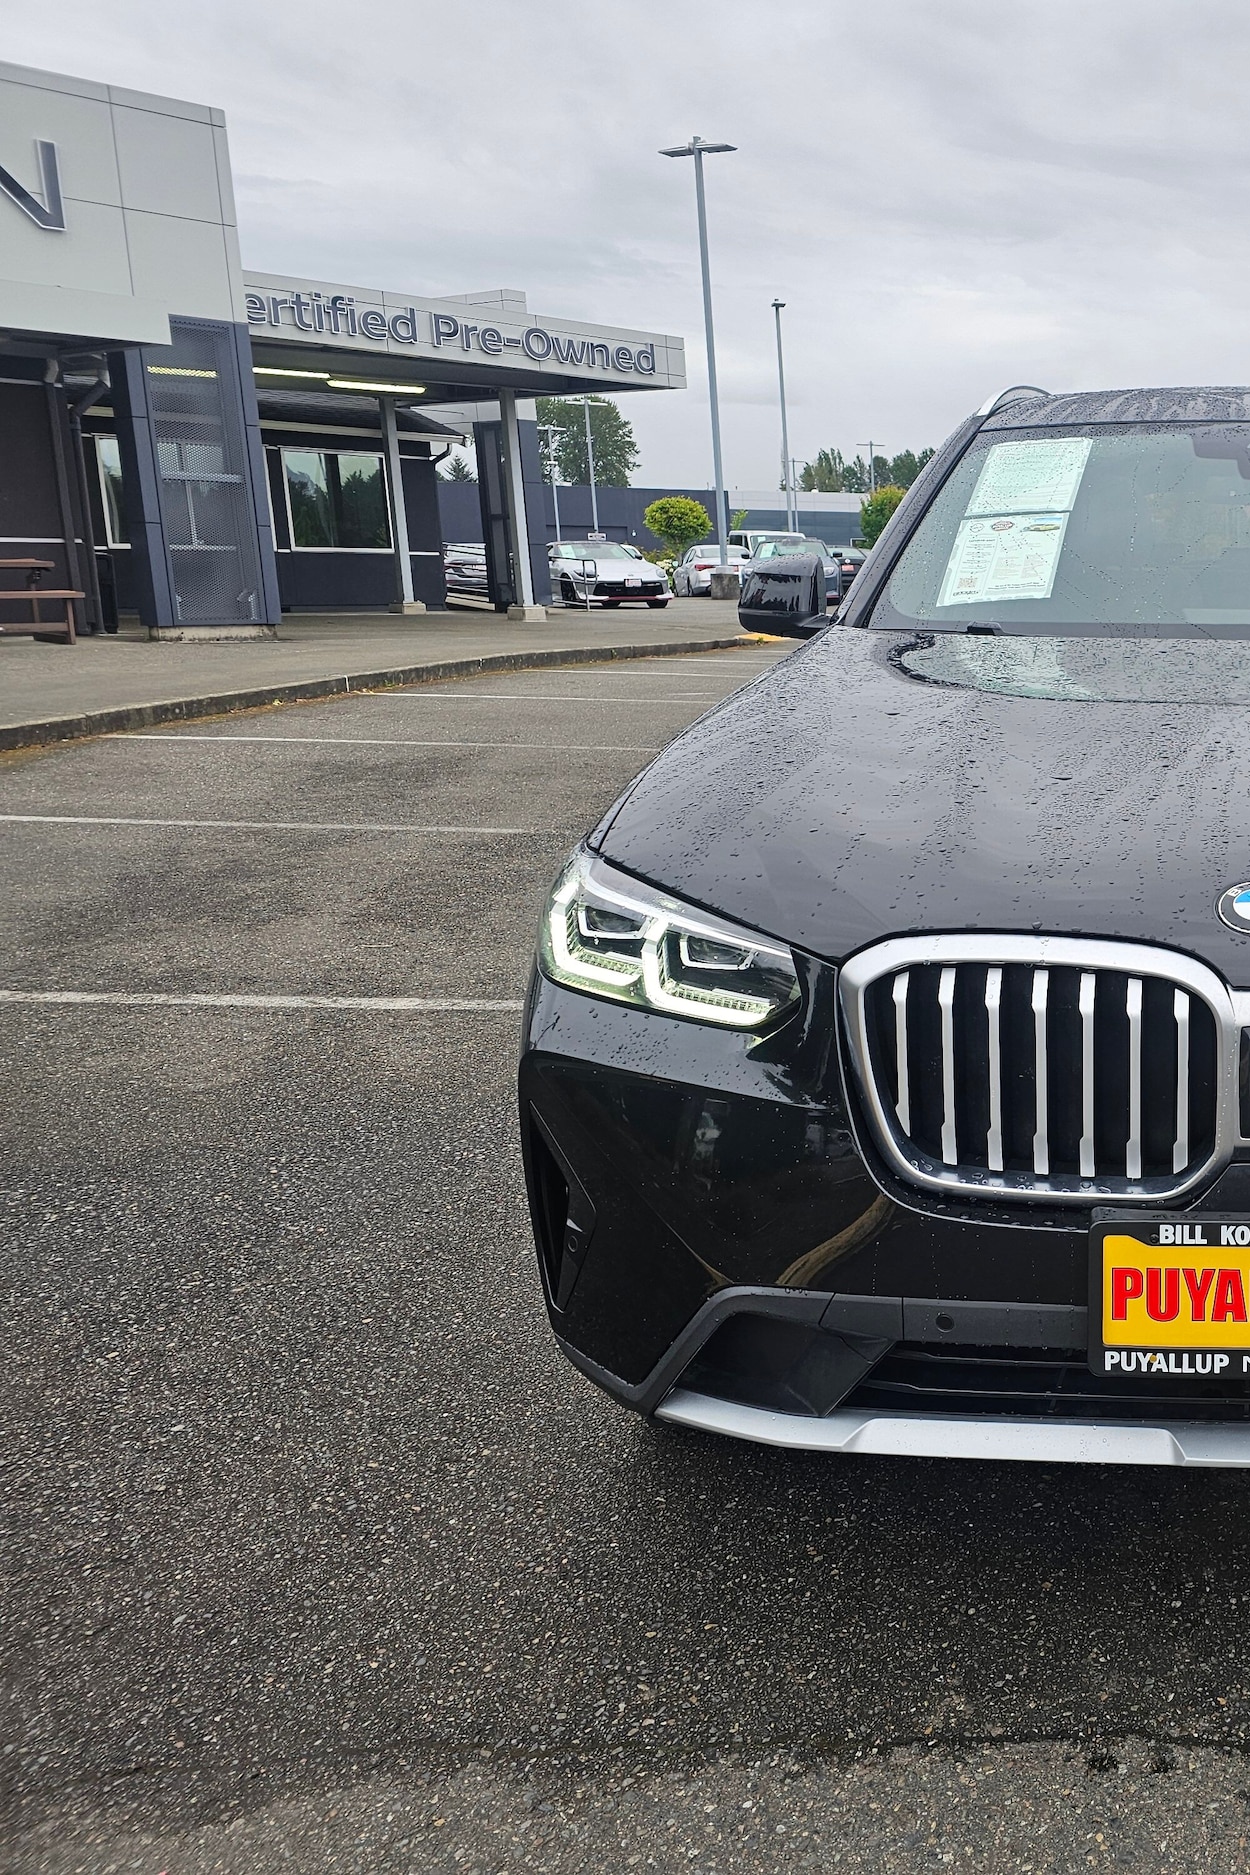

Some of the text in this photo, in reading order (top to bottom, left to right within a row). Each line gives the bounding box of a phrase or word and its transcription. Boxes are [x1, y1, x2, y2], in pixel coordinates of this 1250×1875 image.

[431, 313, 657, 376] Pre-Owned
[1159, 1224, 1208, 1245] BILL
[1104, 1351, 1230, 1375] PUYALLUP
